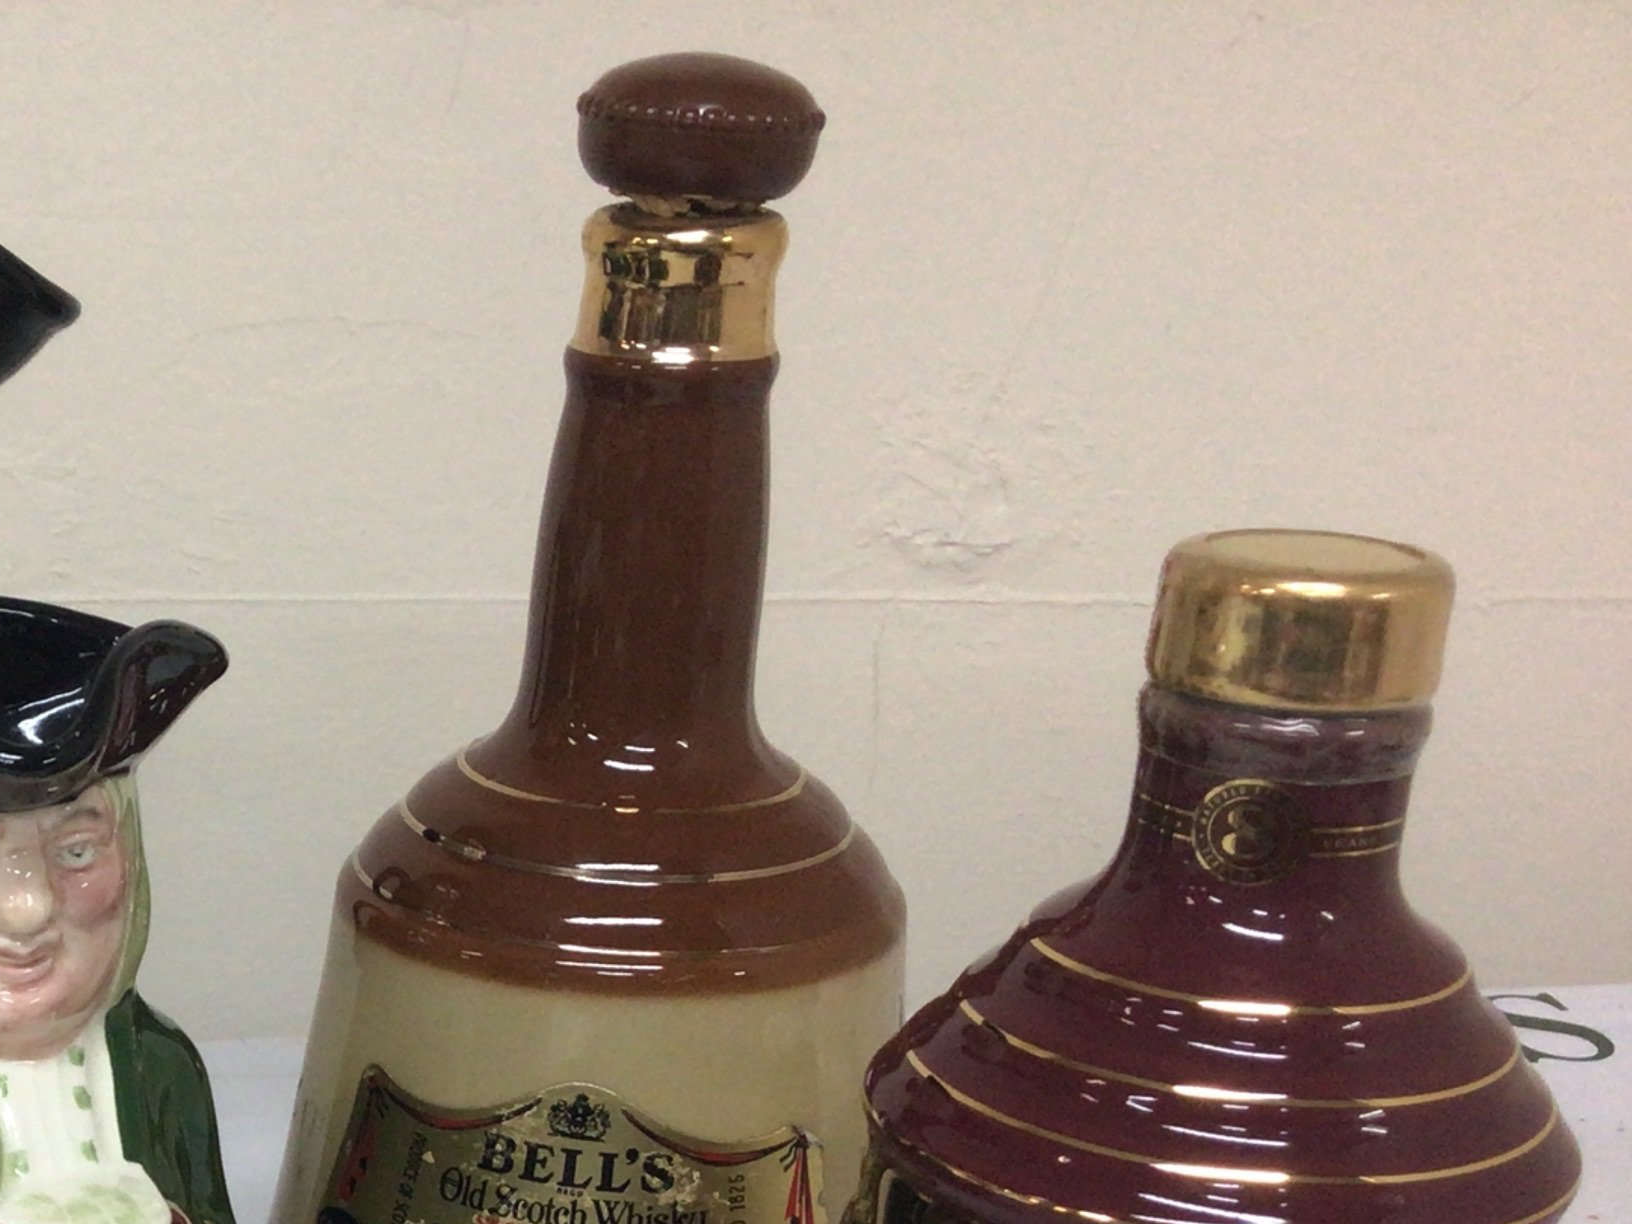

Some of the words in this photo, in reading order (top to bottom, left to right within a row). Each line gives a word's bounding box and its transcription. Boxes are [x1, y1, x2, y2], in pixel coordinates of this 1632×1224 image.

[477, 1131, 674, 1193] BELL'S
[440, 1167, 488, 1211] Old
[728, 1174, 746, 1211] 1825
